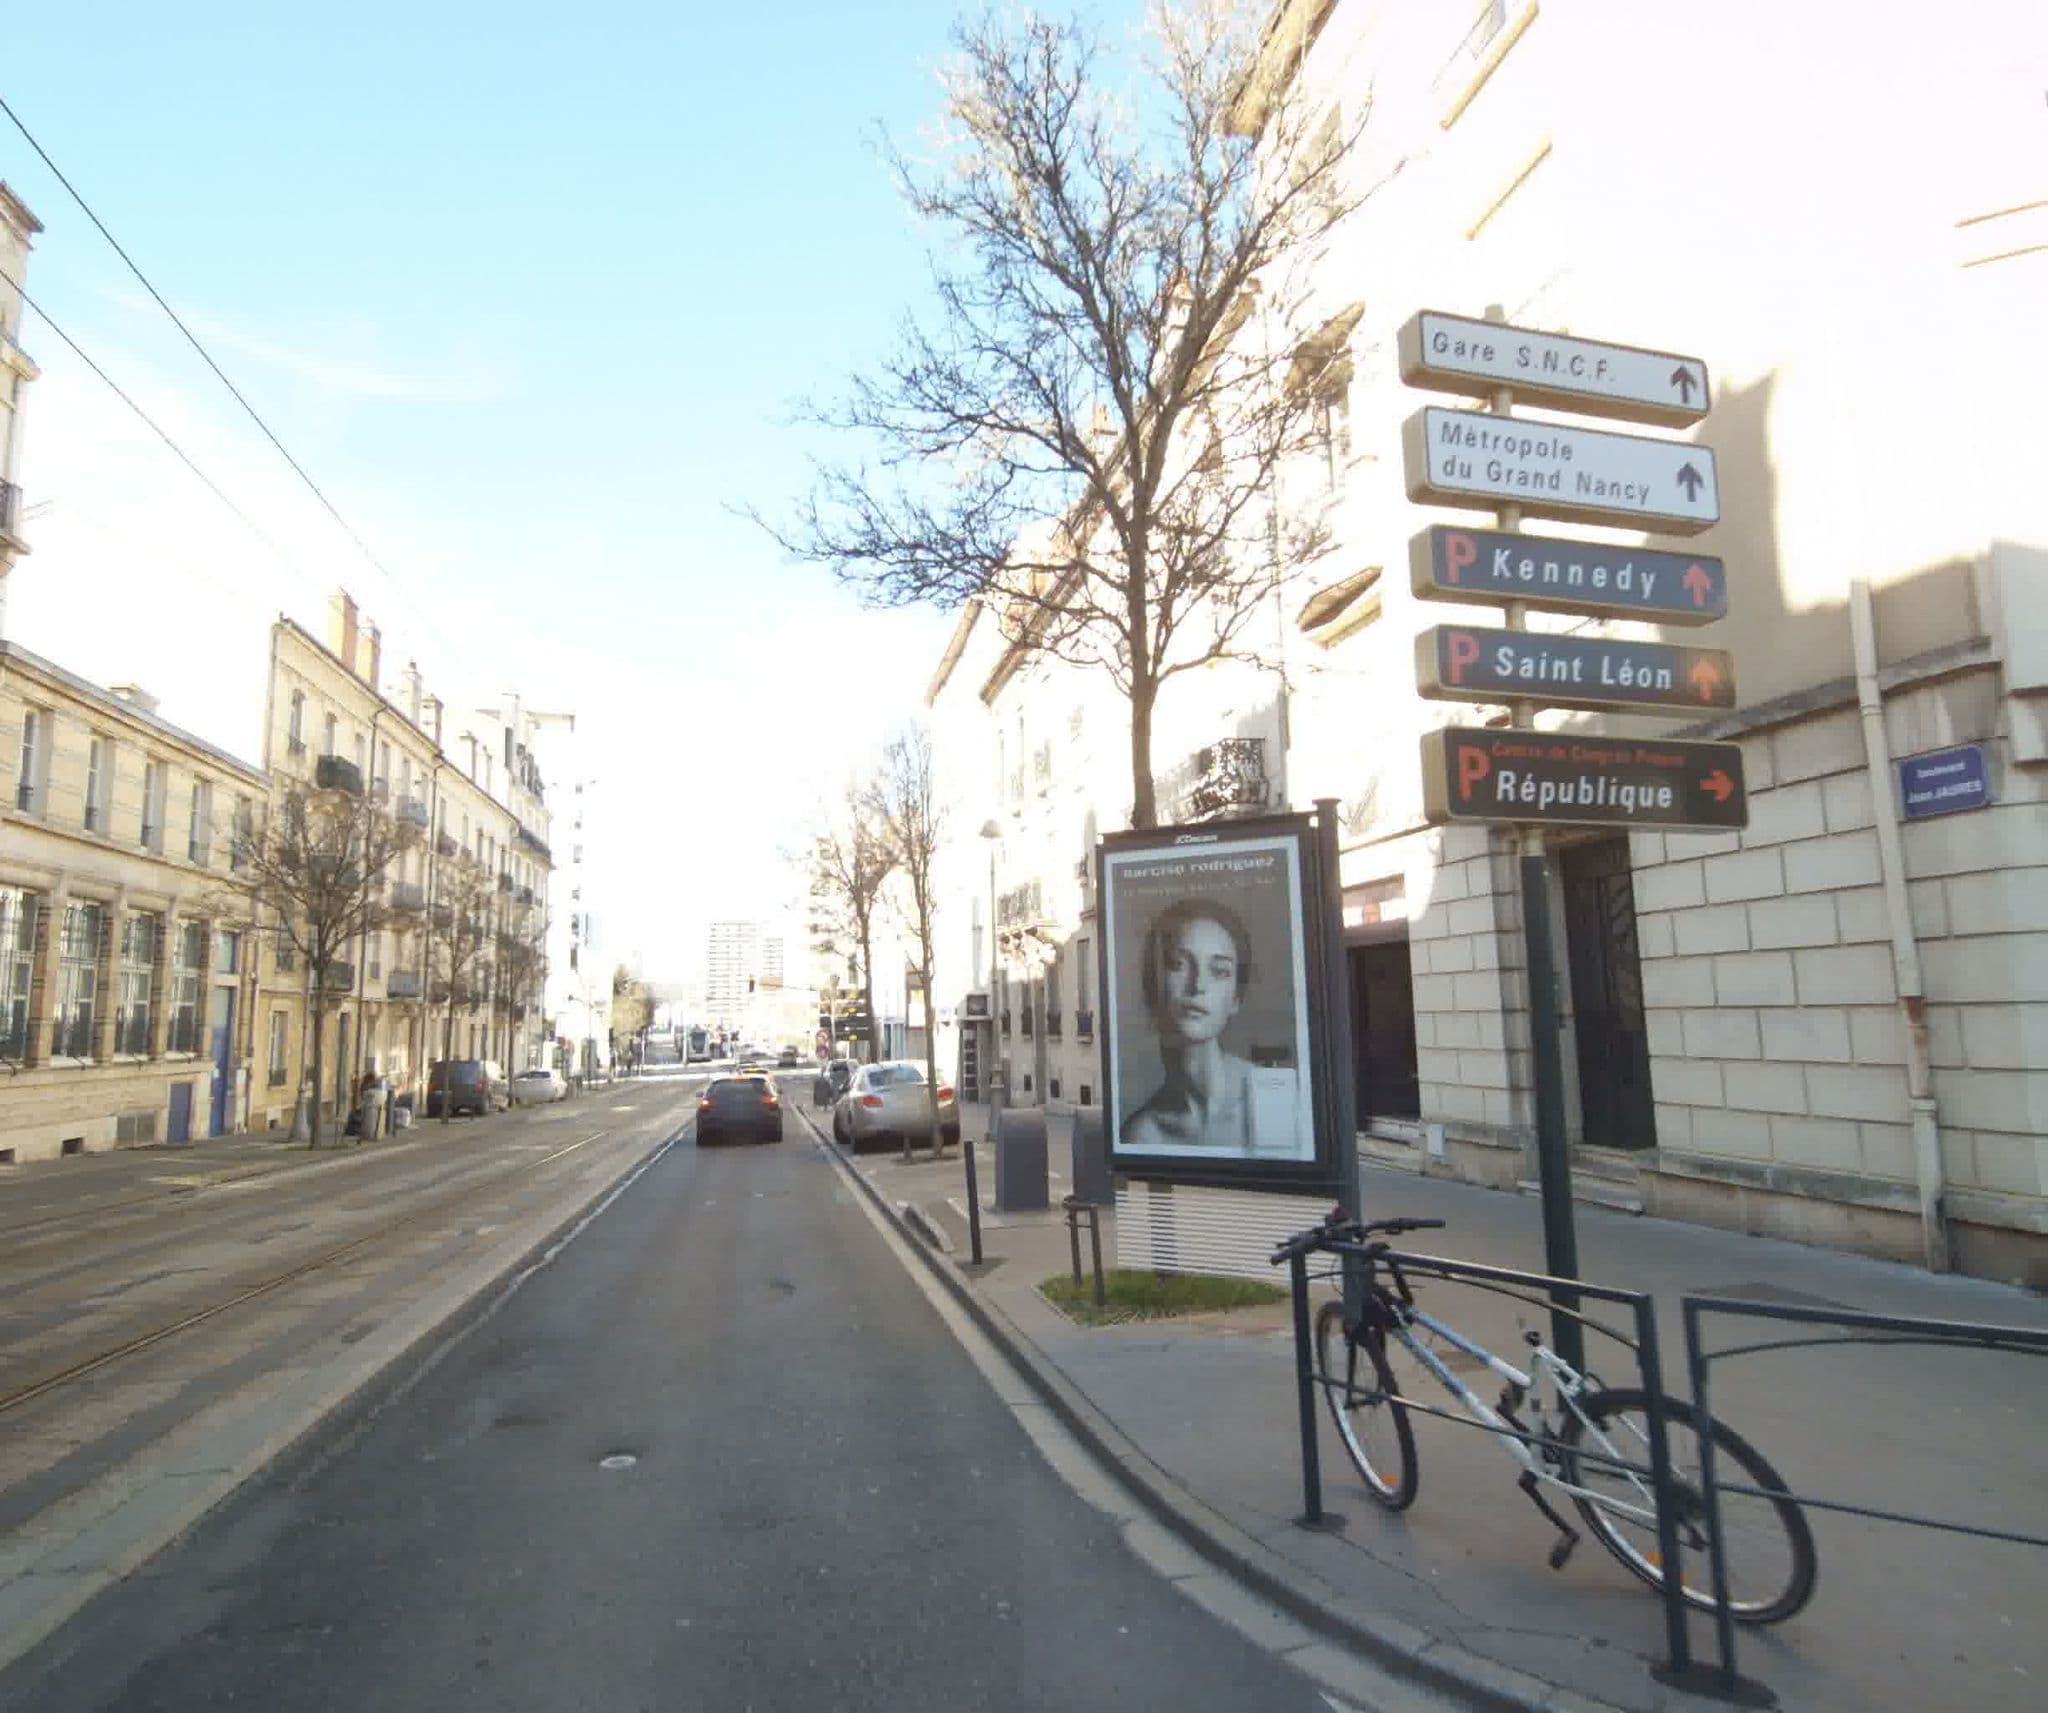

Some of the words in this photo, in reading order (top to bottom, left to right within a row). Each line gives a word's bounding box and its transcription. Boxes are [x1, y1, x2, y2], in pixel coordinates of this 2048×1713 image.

[1432, 331, 1495, 361] Gare
[1516, 345, 1616, 382] S.N.C.F.
[1440, 421, 1574, 461] Métropole
[1443, 455, 1472, 480] du
[1486, 460, 1561, 490] Grand
[1576, 471, 1650, 505] Nancy
[1445, 534, 1478, 583] P
[1492, 548, 1656, 599] Kennedy
[1449, 632, 1480, 685] P
[1495, 647, 1583, 683] Saint
[1602, 655, 1673, 690] Léon
[1458, 745, 1491, 800] P
[1496, 770, 1674, 812] République
